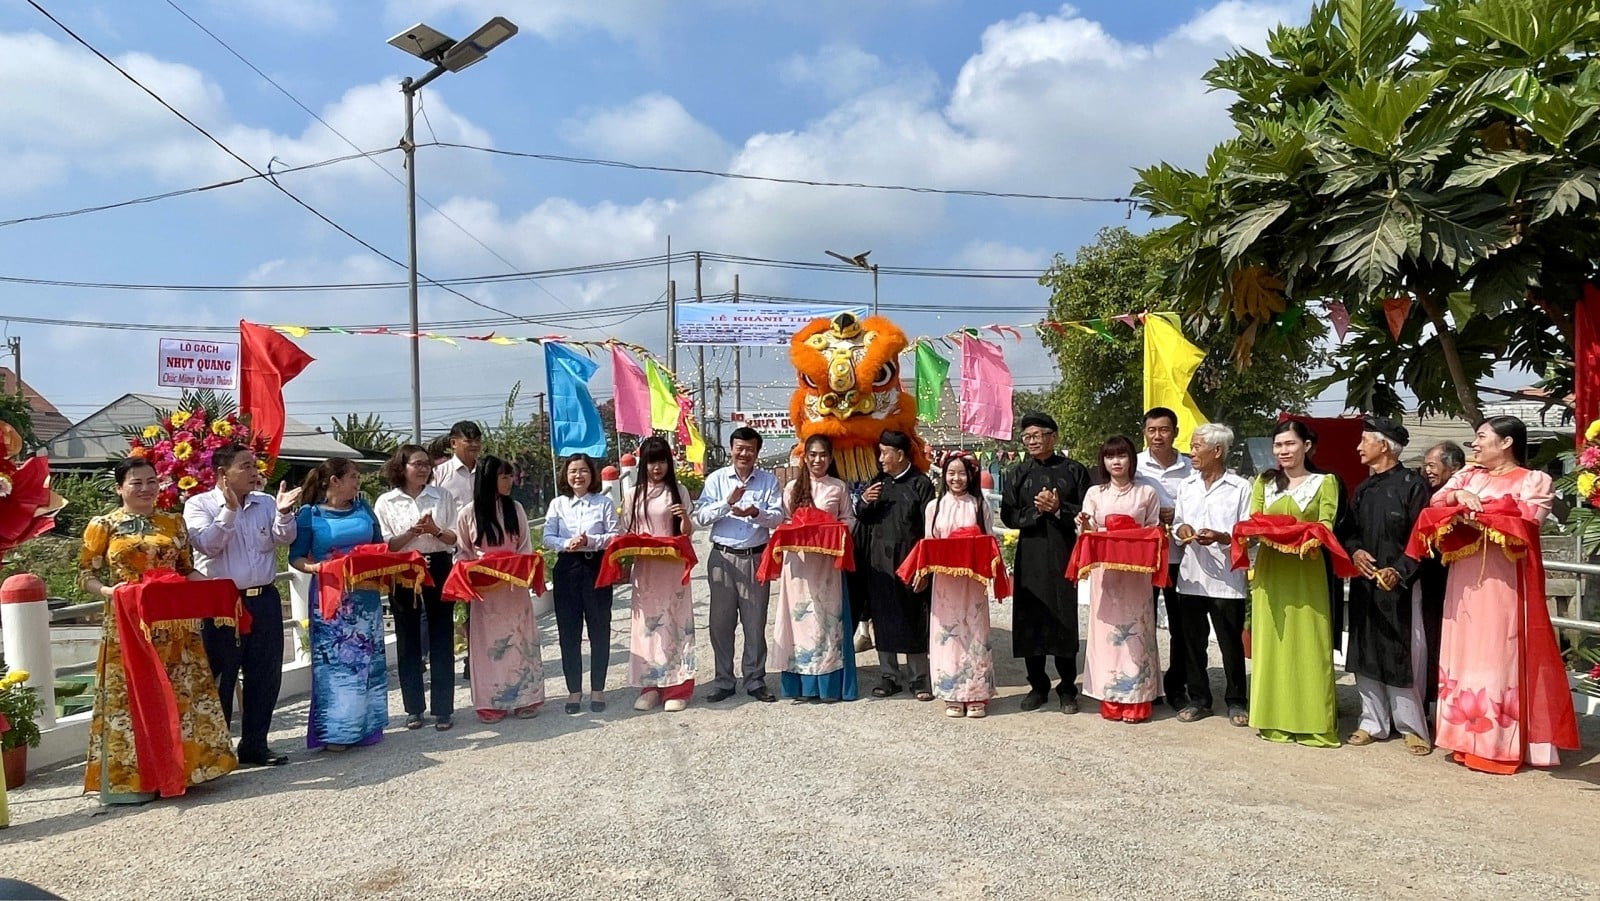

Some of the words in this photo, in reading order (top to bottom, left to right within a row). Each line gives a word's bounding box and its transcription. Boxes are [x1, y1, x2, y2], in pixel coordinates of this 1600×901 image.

[180, 343, 191, 352] LÒ
[194, 344, 219, 354] GẠCH
[166, 357, 194, 371] NHỤT
[197, 358, 231, 372] QUANG
